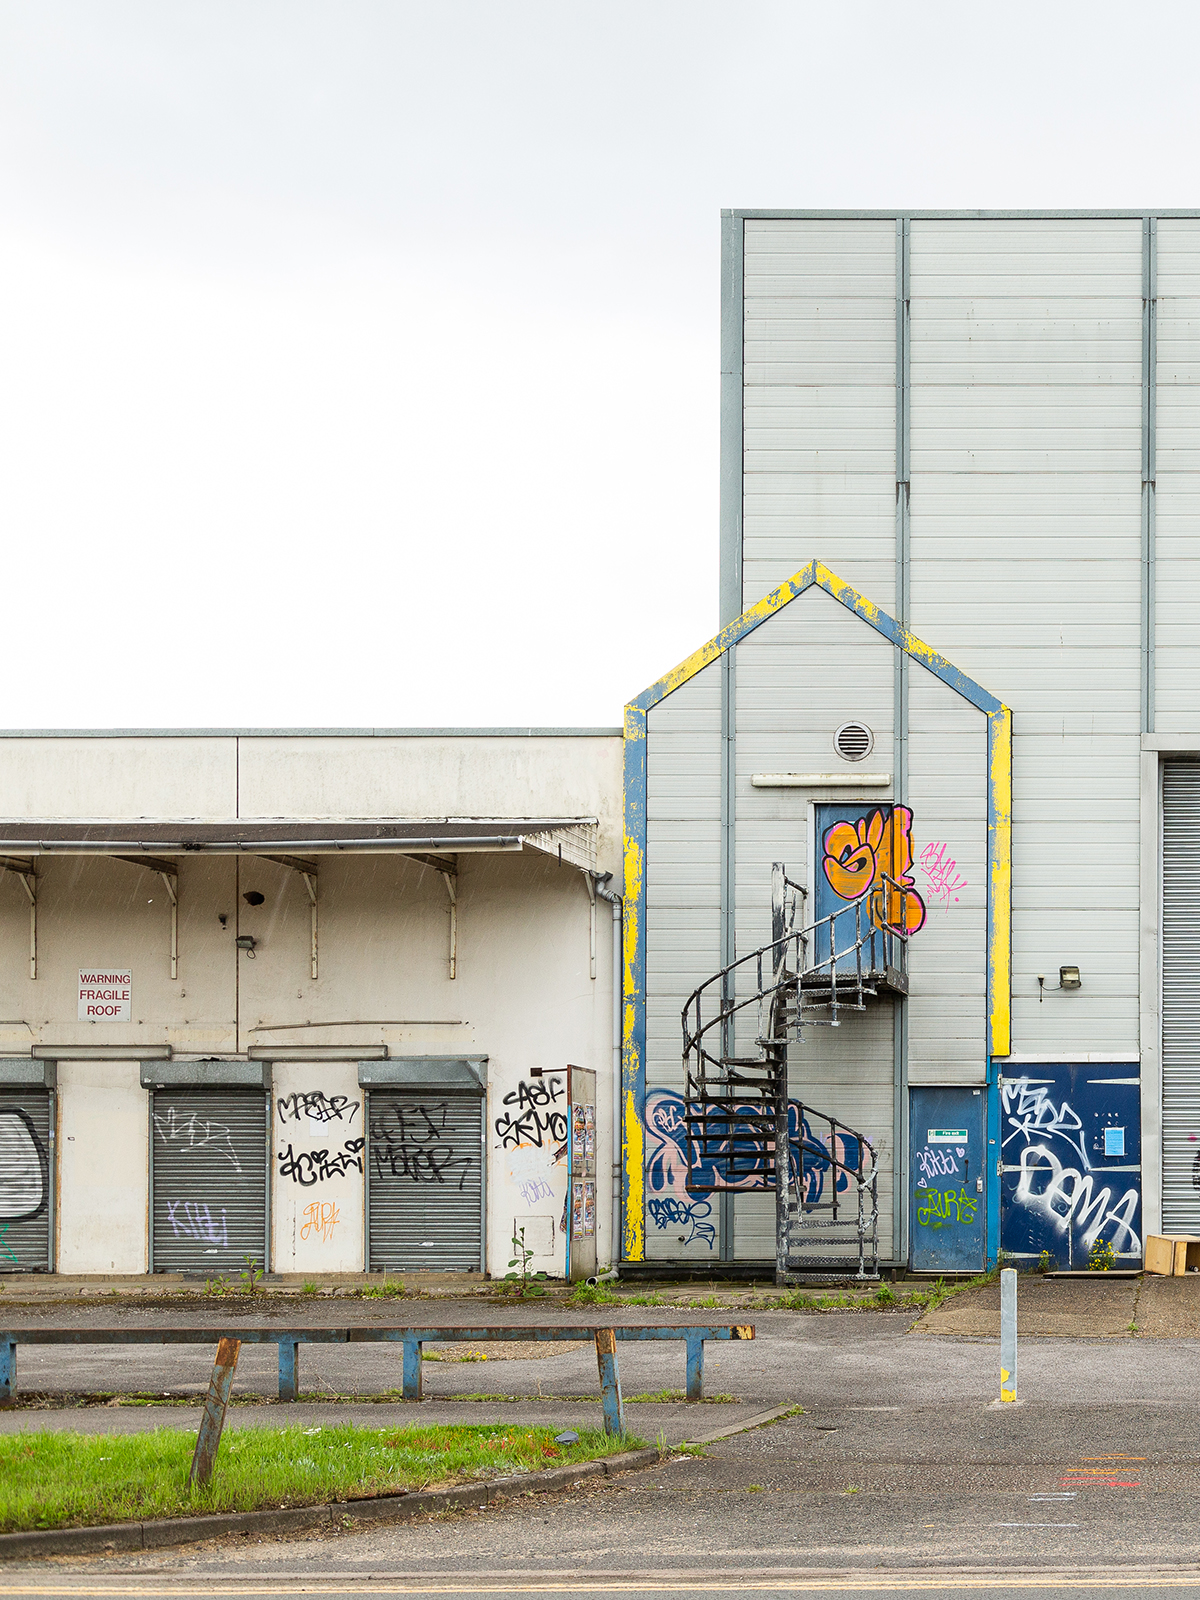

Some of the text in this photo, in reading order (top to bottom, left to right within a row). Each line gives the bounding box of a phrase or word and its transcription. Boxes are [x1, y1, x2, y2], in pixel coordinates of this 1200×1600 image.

[80, 974, 131, 984] WARNING
[80, 989, 130, 1000] FRAGILE
[87, 1005, 122, 1016] ROOF
